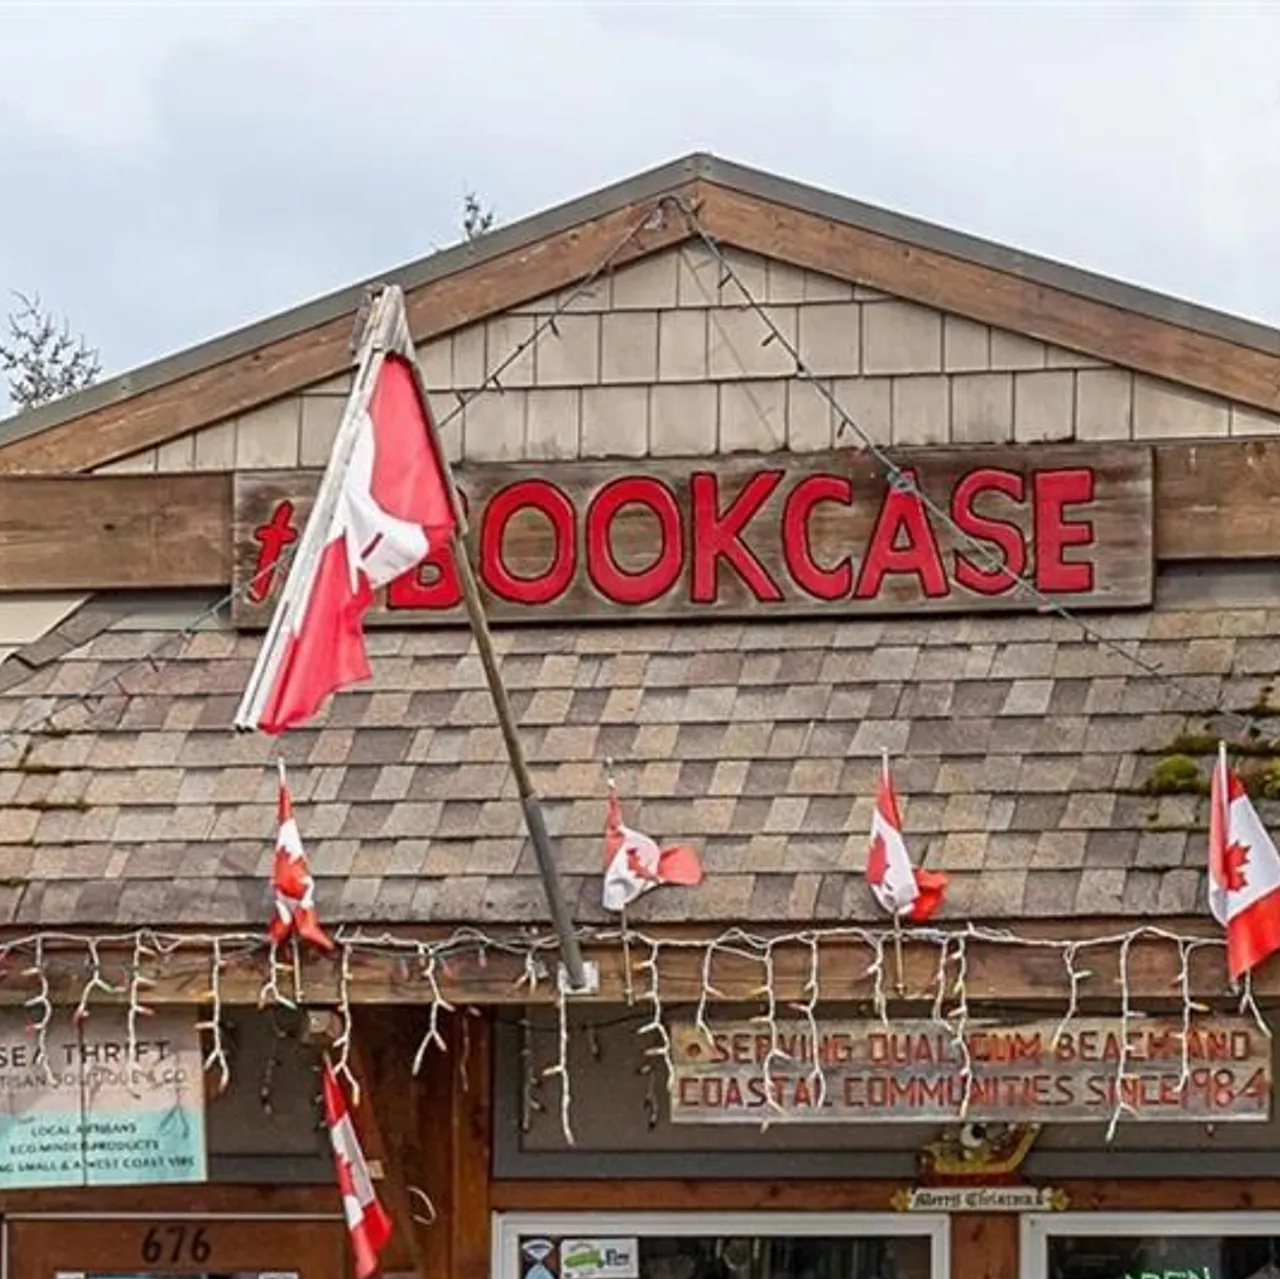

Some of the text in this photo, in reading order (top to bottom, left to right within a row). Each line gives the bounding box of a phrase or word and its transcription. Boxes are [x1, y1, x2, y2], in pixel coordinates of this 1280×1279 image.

[711, 1031, 1252, 1064] SERVING QUALCUM BEACH AND
[679, 1076, 832, 1109] COASTAL
[844, 1075, 1074, 1109] COMMUNITIES
[1084, 1074, 1180, 1106] SINCE
[30, 1124, 70, 1138] LOCAL
[122, 1156, 166, 1170] COAST
[141, 1224, 212, 1266] 676
